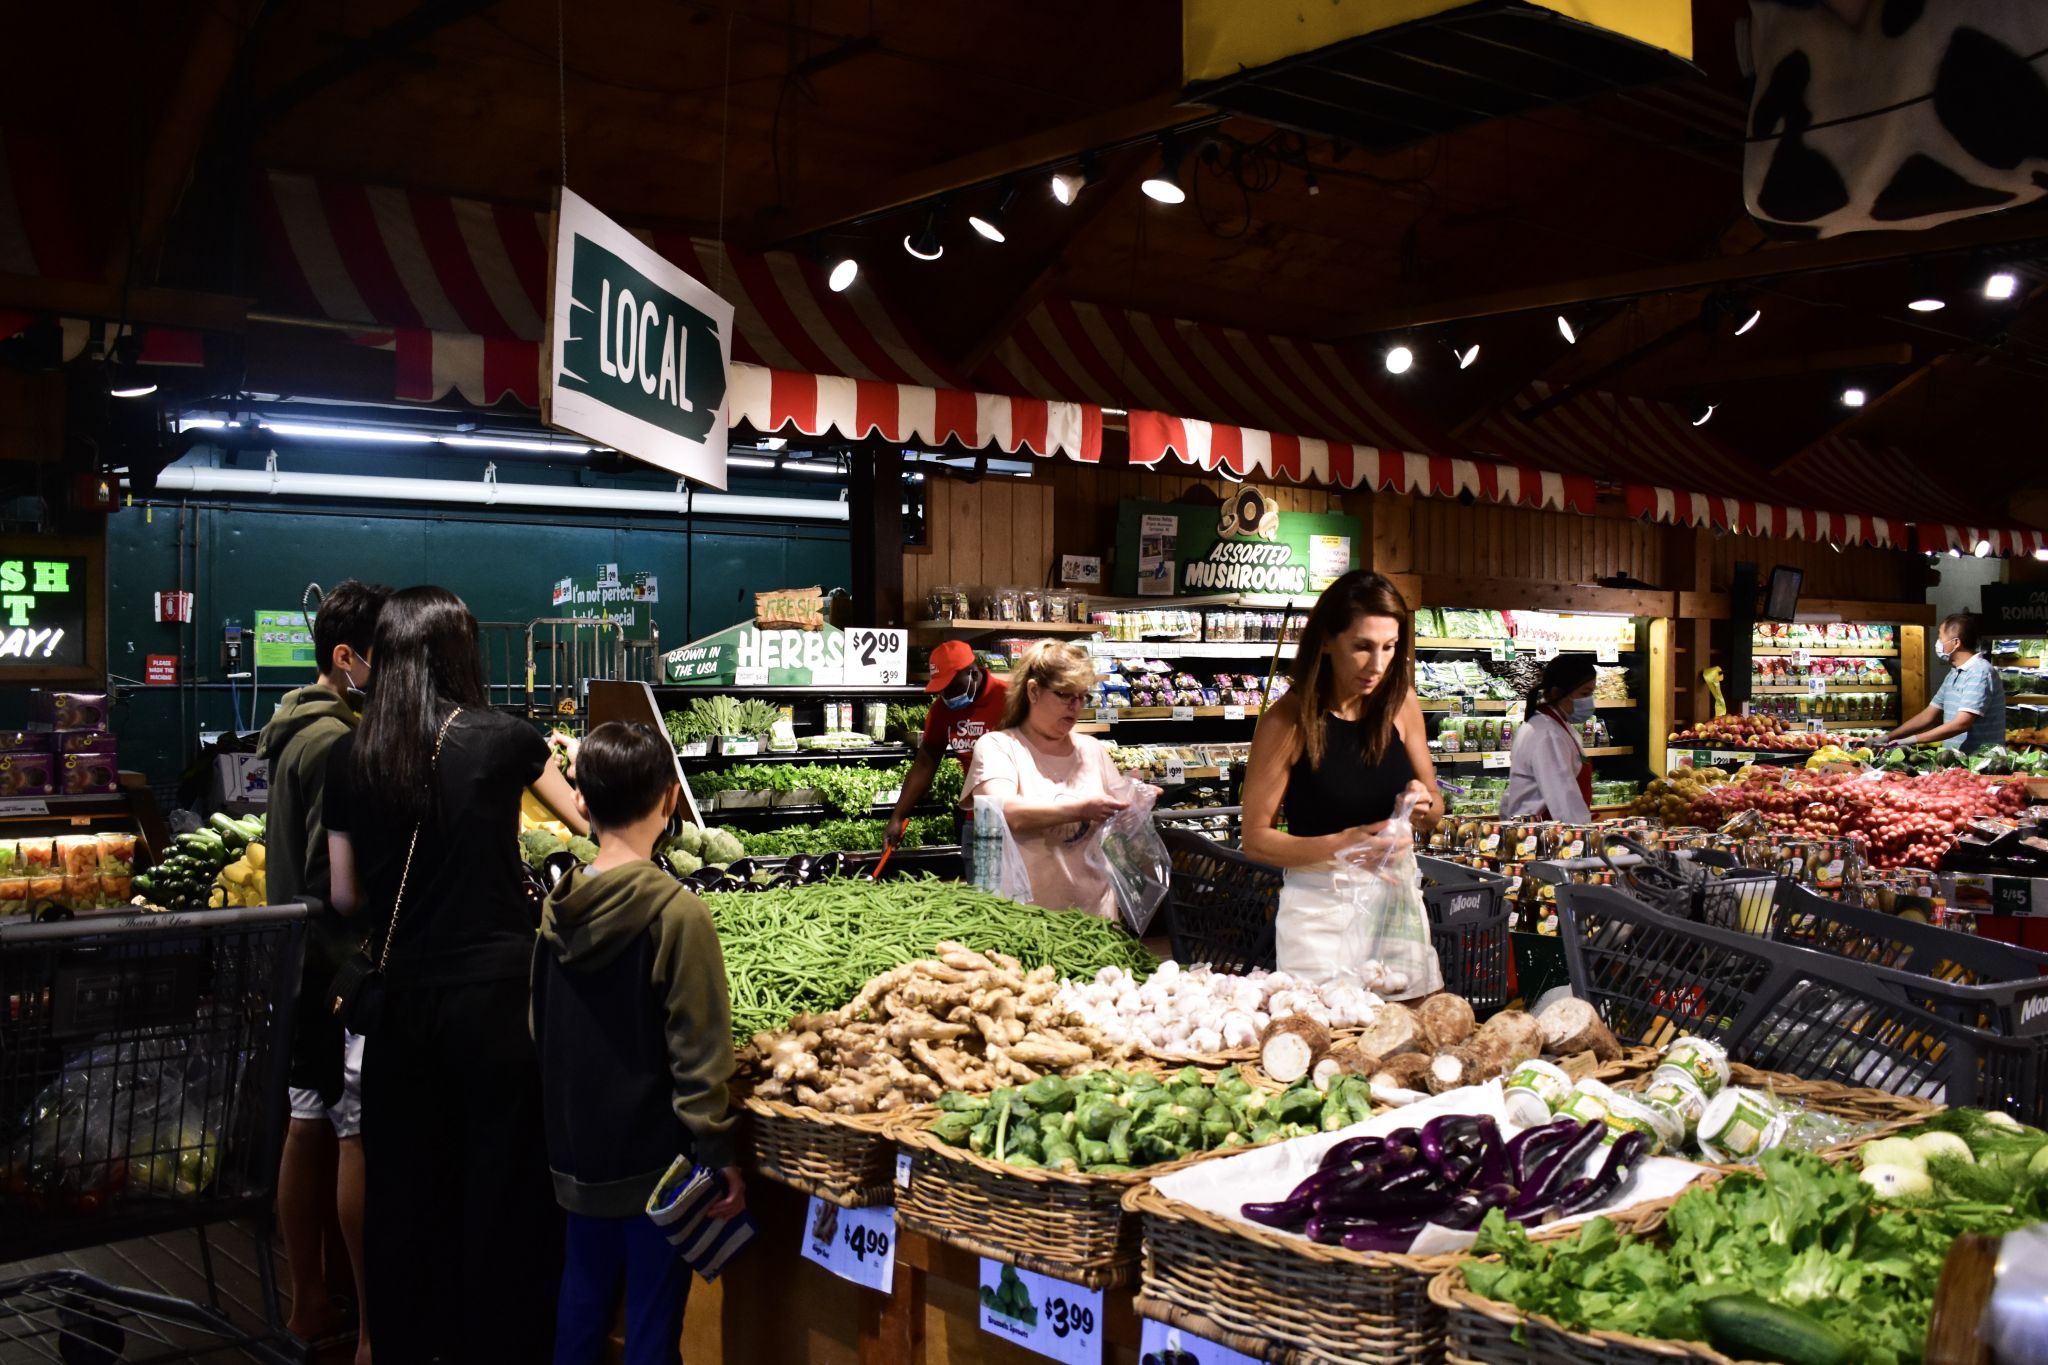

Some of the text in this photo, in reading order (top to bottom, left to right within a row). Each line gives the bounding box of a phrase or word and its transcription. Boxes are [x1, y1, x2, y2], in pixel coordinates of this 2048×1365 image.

[599, 278, 694, 413] LOCAL
[1209, 542, 1292, 566] ASSORTED
[1185, 561, 1306, 592] MUSHROOMS
[572, 584, 635, 606] I'm not perfect
[764, 598, 817, 619] FRESH
[668, 646, 722, 663] GROWN IN
[737, 627, 845, 669] HERBS
[674, 661, 718, 677] THE USA
[1009, 1324, 1029, 1339] Sprouts
